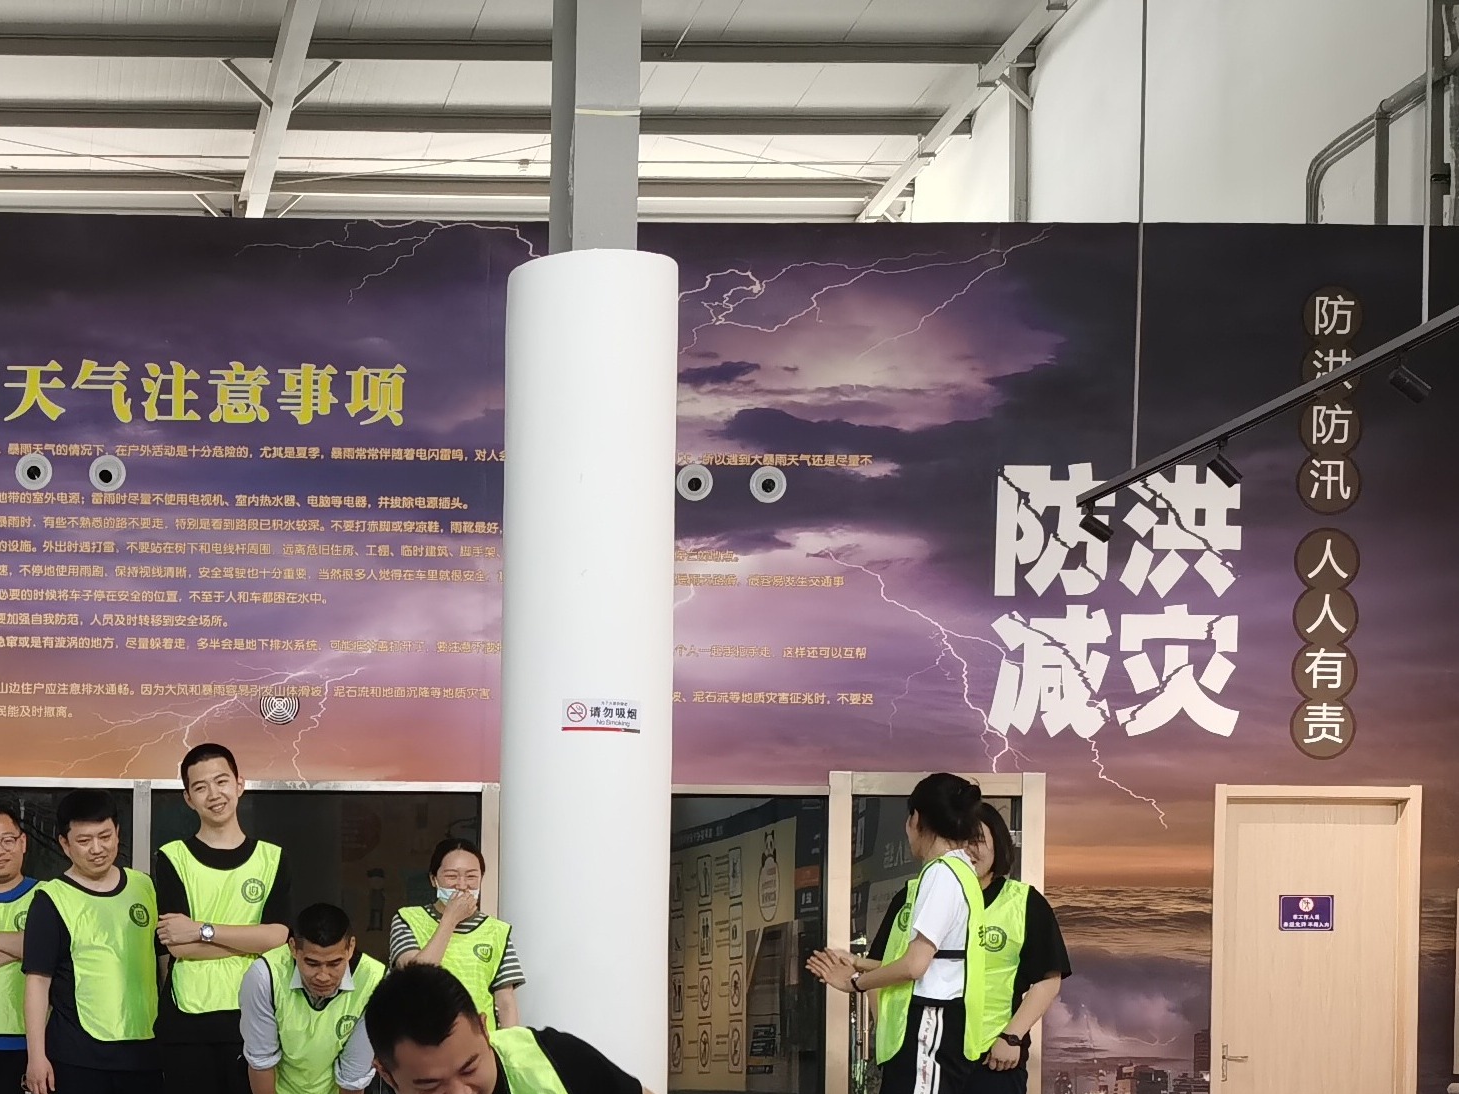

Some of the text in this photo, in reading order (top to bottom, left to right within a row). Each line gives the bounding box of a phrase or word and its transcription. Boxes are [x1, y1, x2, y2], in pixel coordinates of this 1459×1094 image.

[994, 463, 1242, 598] 防洪
[988, 604, 1240, 738] 减灾
[1303, 538, 1349, 744] 人人有责
[590, 706, 637, 720] 请勿吸烟
[606, 720, 630, 728] Smoking
